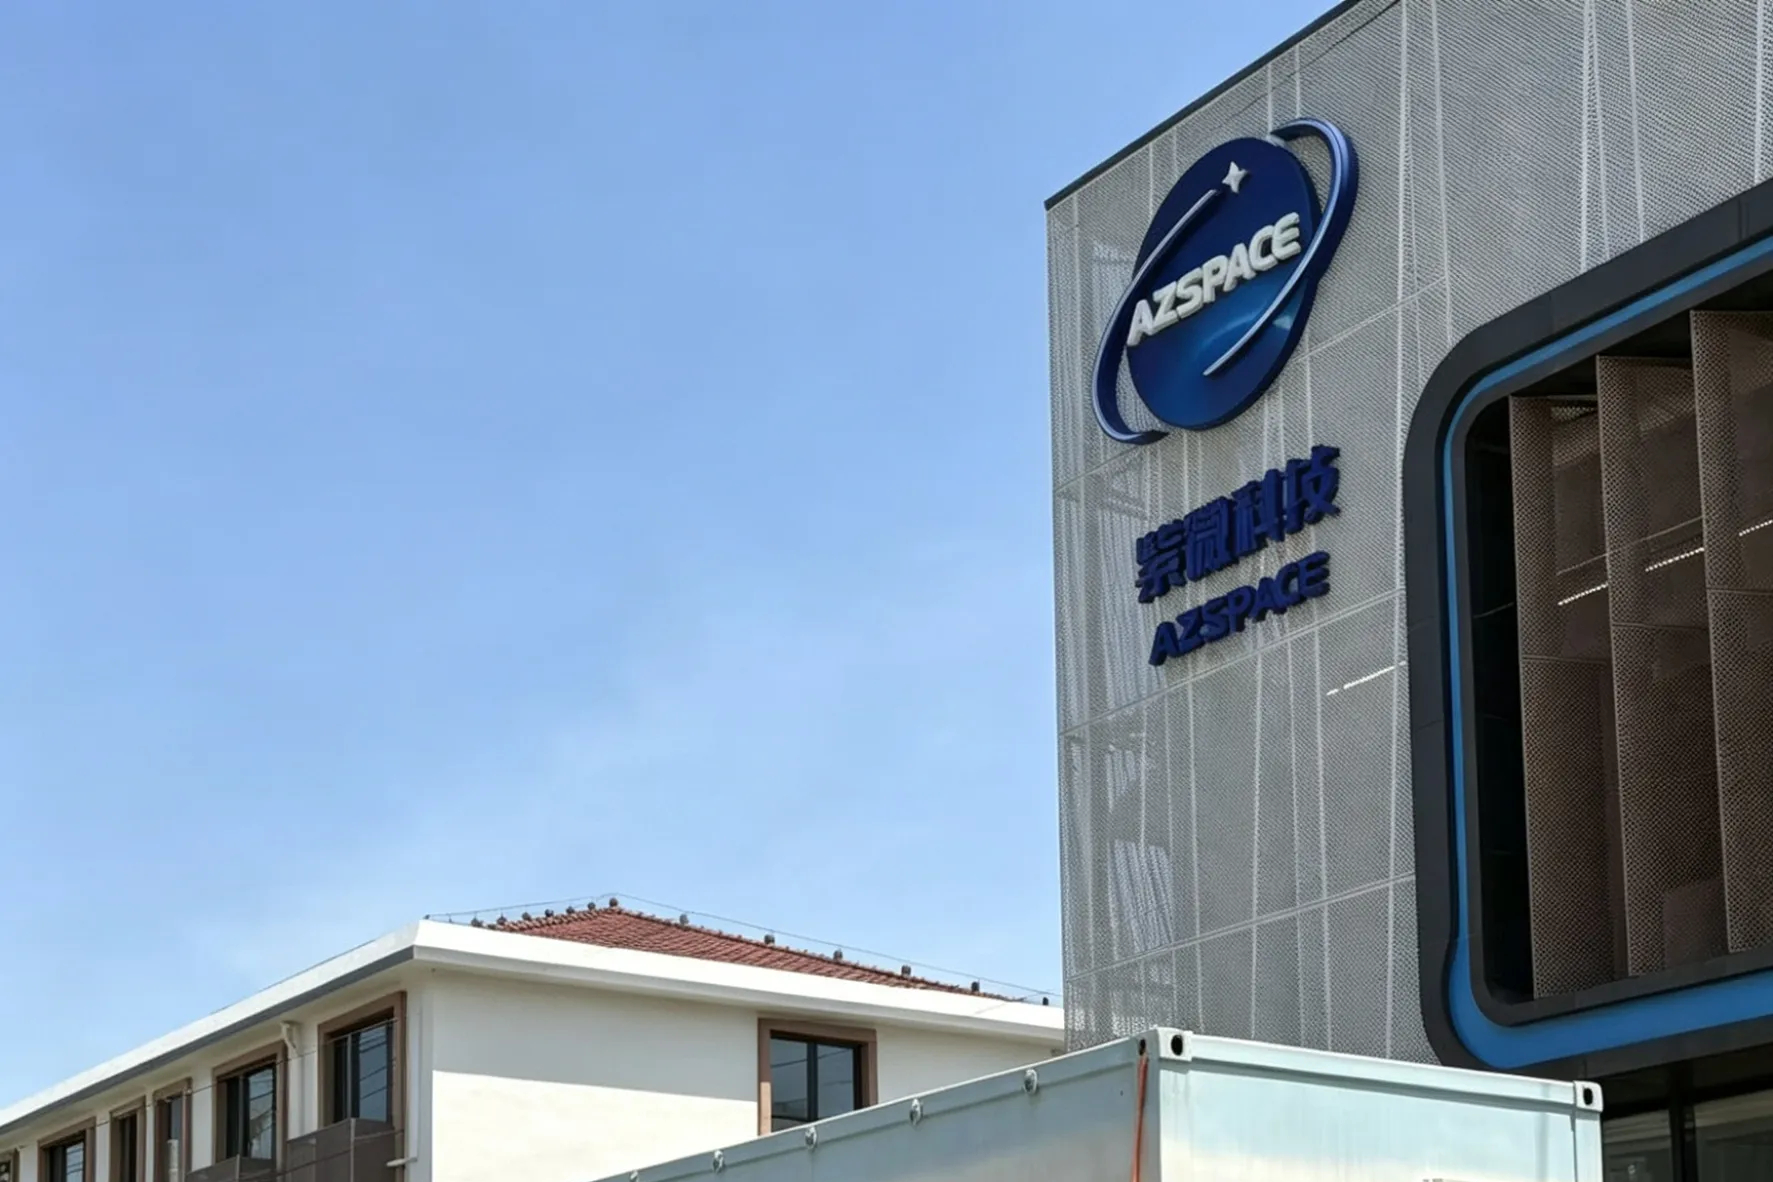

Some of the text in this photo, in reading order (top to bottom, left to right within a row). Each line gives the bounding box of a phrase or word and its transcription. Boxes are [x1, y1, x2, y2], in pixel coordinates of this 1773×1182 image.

[1127, 211, 1302, 346] AZSPACE
[1136, 444, 1340, 603] 紫微科技
[1148, 550, 1331, 666] AZSPACE
